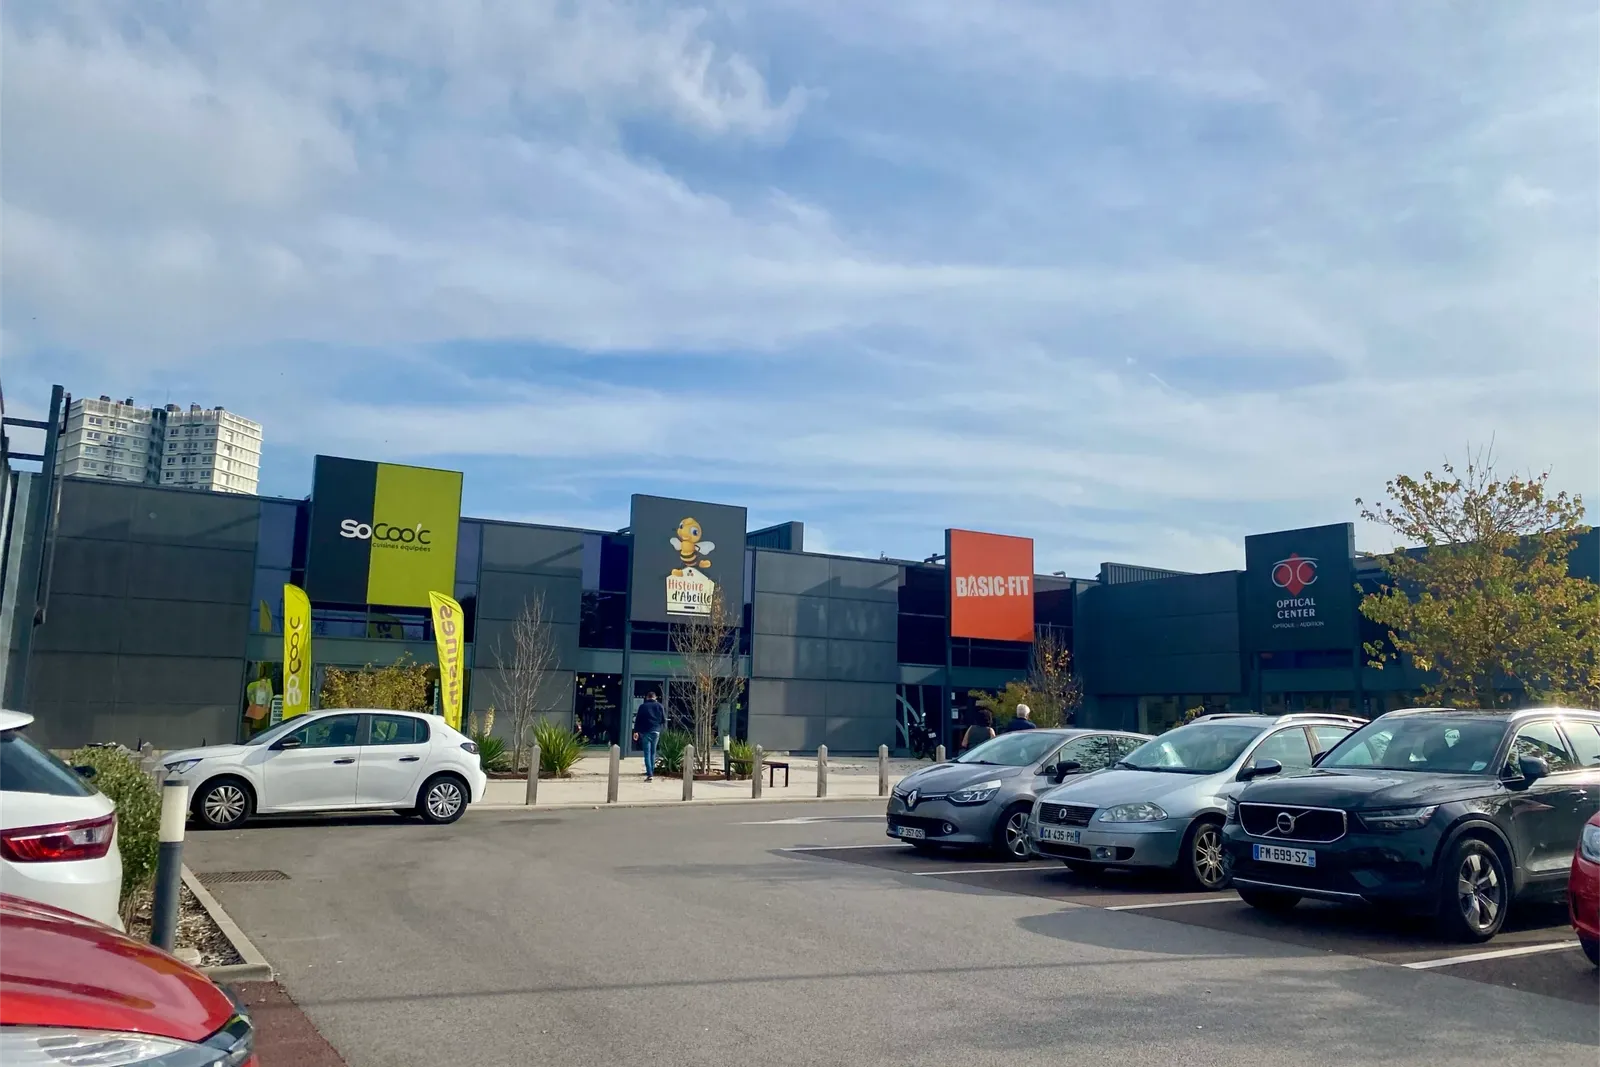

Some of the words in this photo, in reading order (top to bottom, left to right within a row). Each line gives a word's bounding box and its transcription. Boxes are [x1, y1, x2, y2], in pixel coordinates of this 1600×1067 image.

[668, 579, 703, 592] Histoire
[671, 590, 711, 604] d'Abeille
[1276, 597, 1316, 608] OPTICAL
[1277, 608, 1316, 619] CENTER
[1260, 846, 1307, 864] FM-699-SZ
